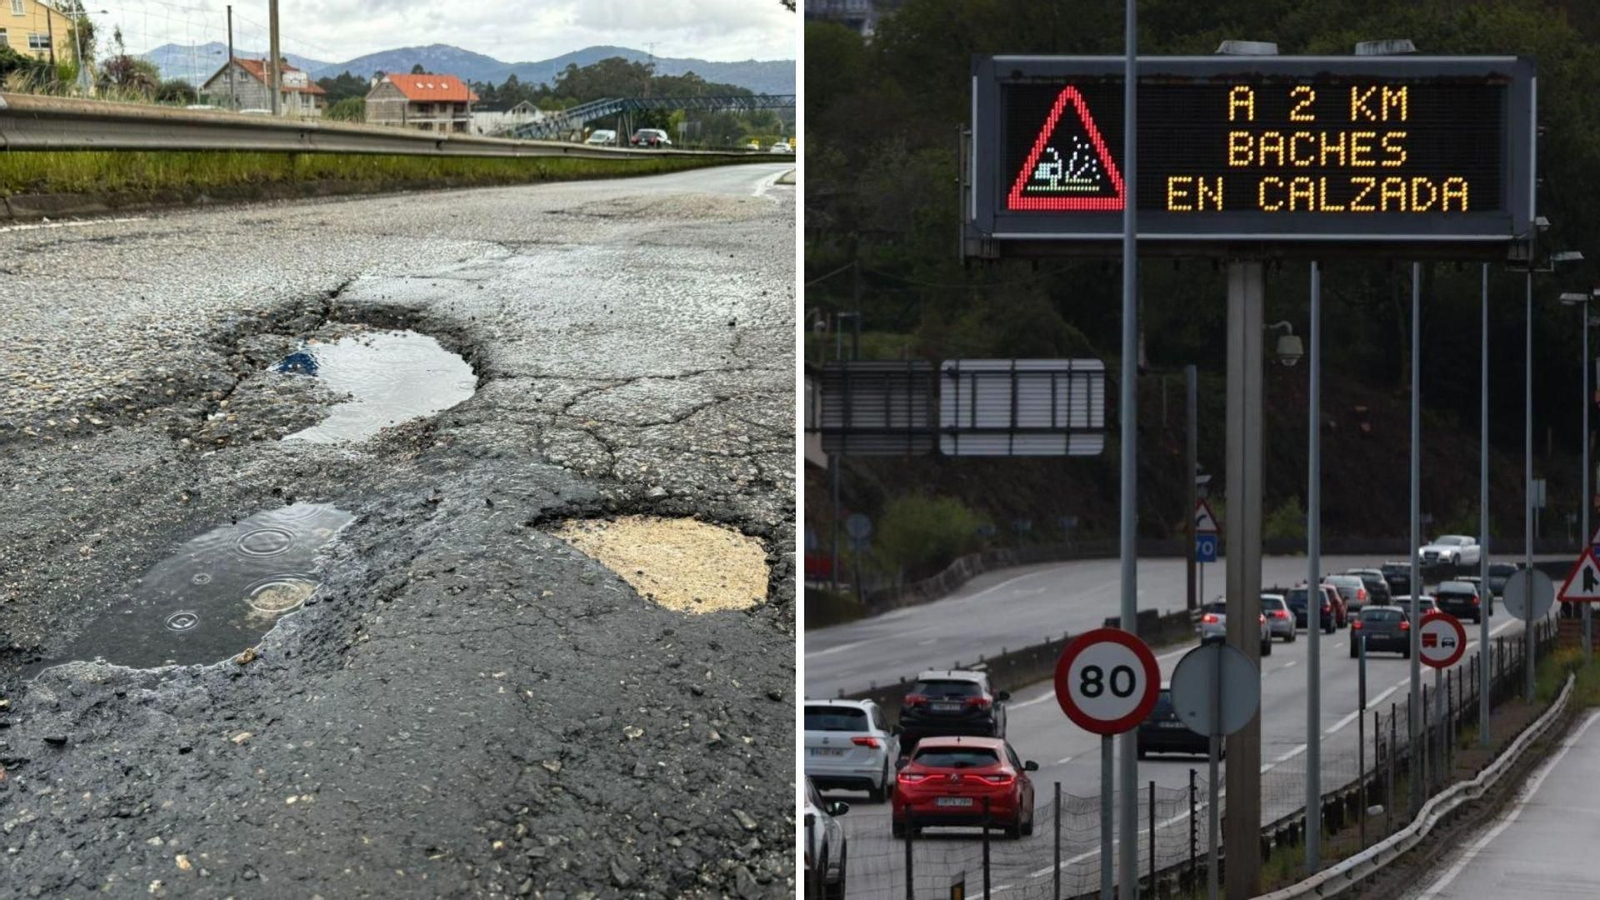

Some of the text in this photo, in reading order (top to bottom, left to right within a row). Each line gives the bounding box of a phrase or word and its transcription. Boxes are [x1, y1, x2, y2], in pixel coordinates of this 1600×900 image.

[1229, 86, 1407, 121] A 2 KM
[1229, 132, 1406, 166] BACHES
[1168, 177, 1467, 211] EN CALZADA
[1080, 665, 1136, 698] 80
